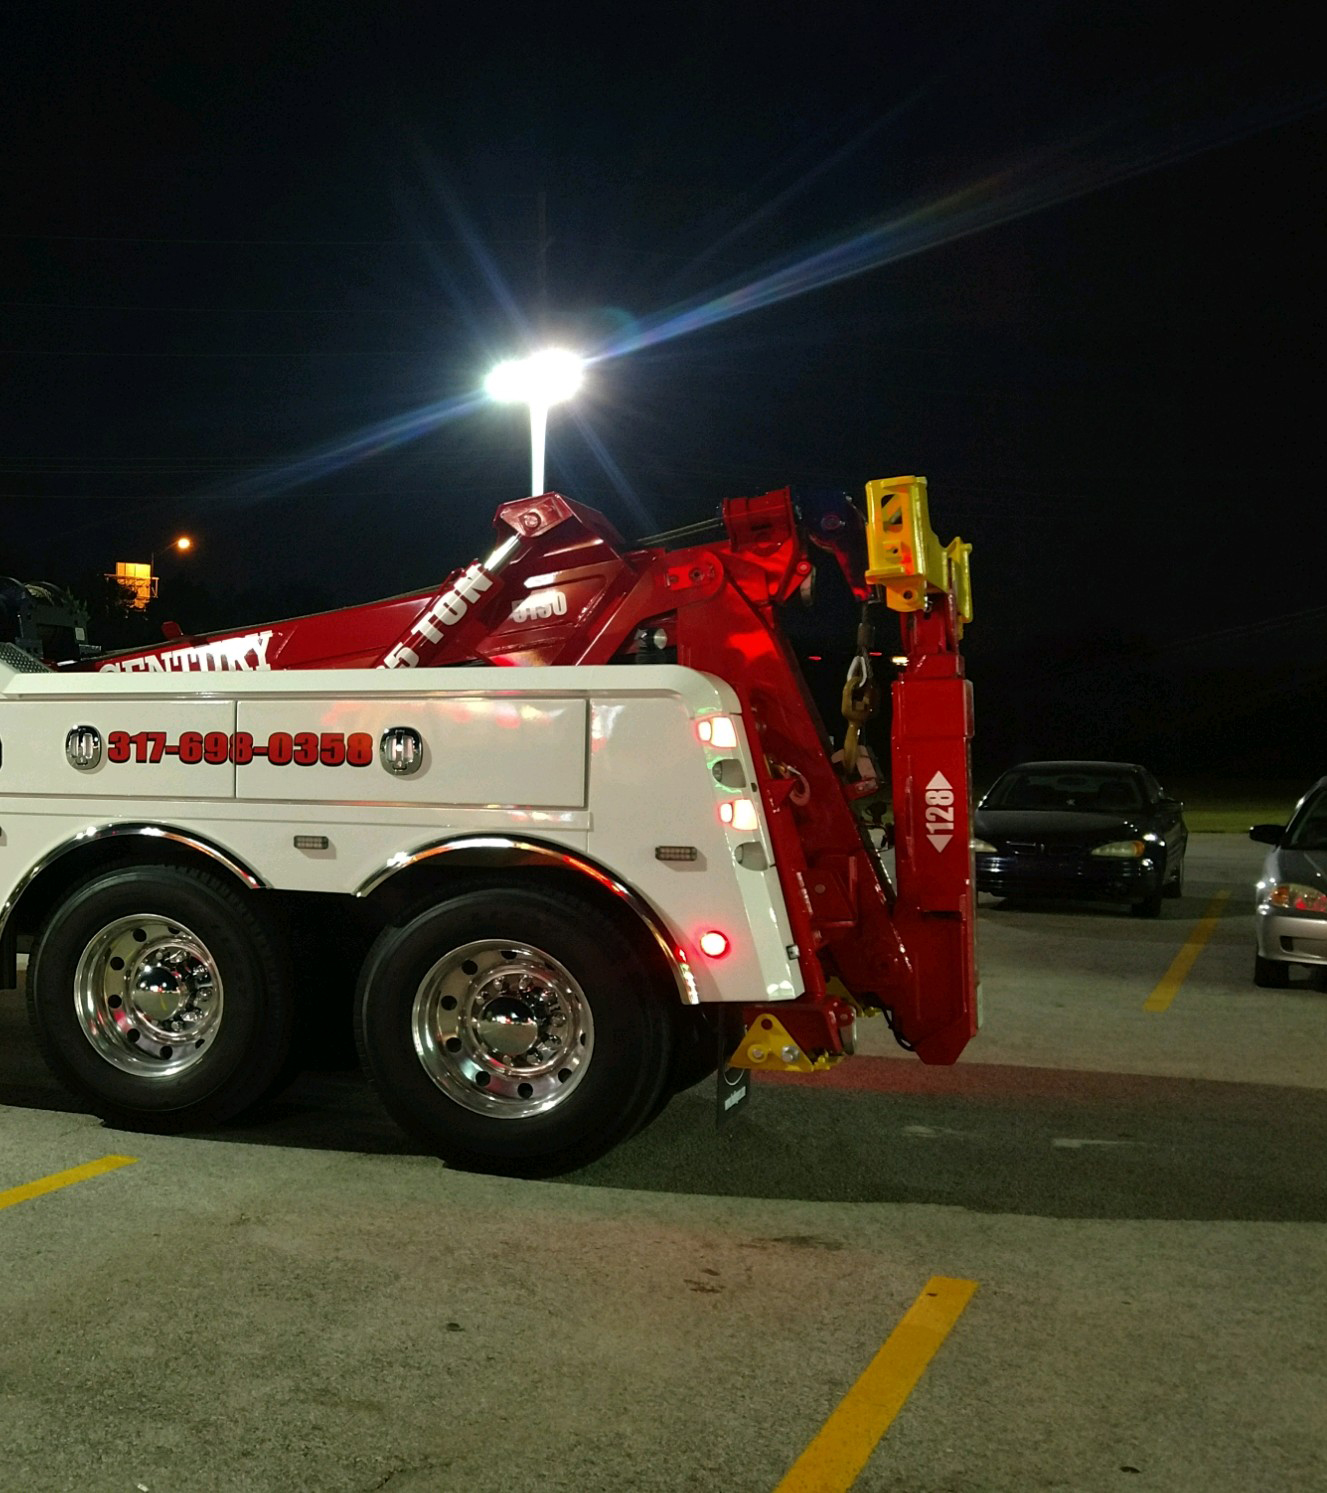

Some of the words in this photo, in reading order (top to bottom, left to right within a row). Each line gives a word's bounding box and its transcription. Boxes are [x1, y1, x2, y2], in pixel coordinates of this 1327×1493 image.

[375, 642, 420, 670] 5
[410, 563, 494, 645] TON
[100, 630, 273, 672] TURY
[108, 731, 373, 767] 317-698-0358
[925, 790, 954, 834] 128
